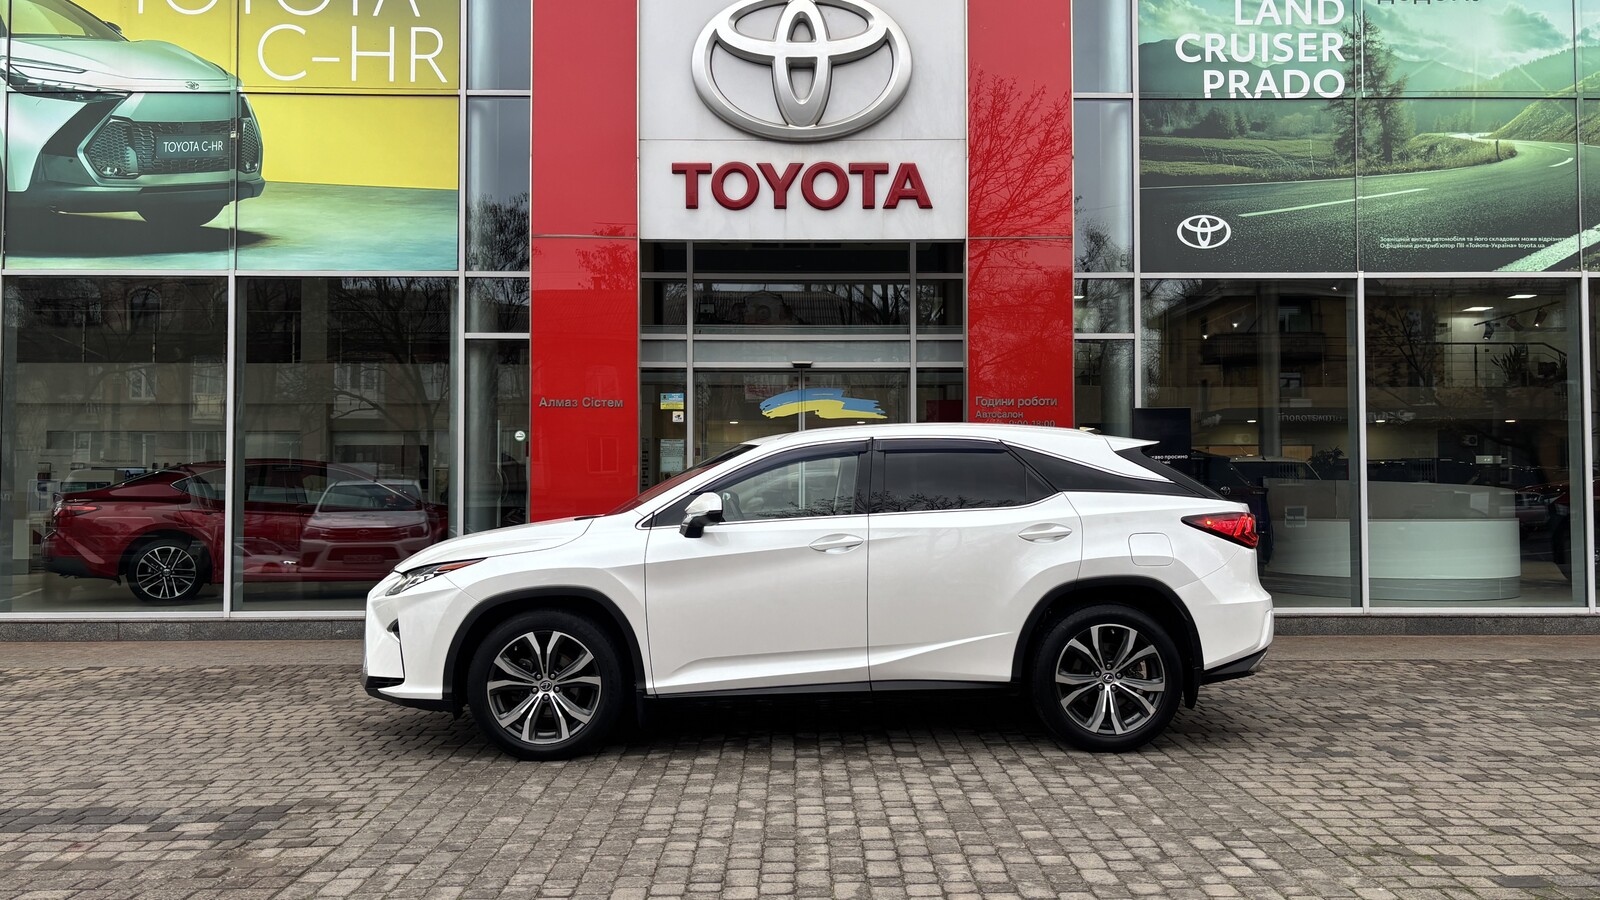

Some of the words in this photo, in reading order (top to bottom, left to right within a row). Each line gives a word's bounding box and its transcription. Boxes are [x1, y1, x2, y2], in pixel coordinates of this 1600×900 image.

[1234, 0, 1346, 25] LAND
[257, 23, 448, 83] C-HR
[1175, 32, 1346, 63] CRUISER
[1203, 69, 1346, 99] PRADO
[163, 141, 200, 153] TOYOTA
[201, 140, 224, 152] C-HR
[671, 161, 934, 211] TOYOTA
[539, 397, 578, 407] Алмаз
[582, 397, 624, 407] Сістем
[975, 396, 1014, 408] Години
[1018, 396, 1058, 408] роботи
[975, 410, 1024, 418] Автосалон
